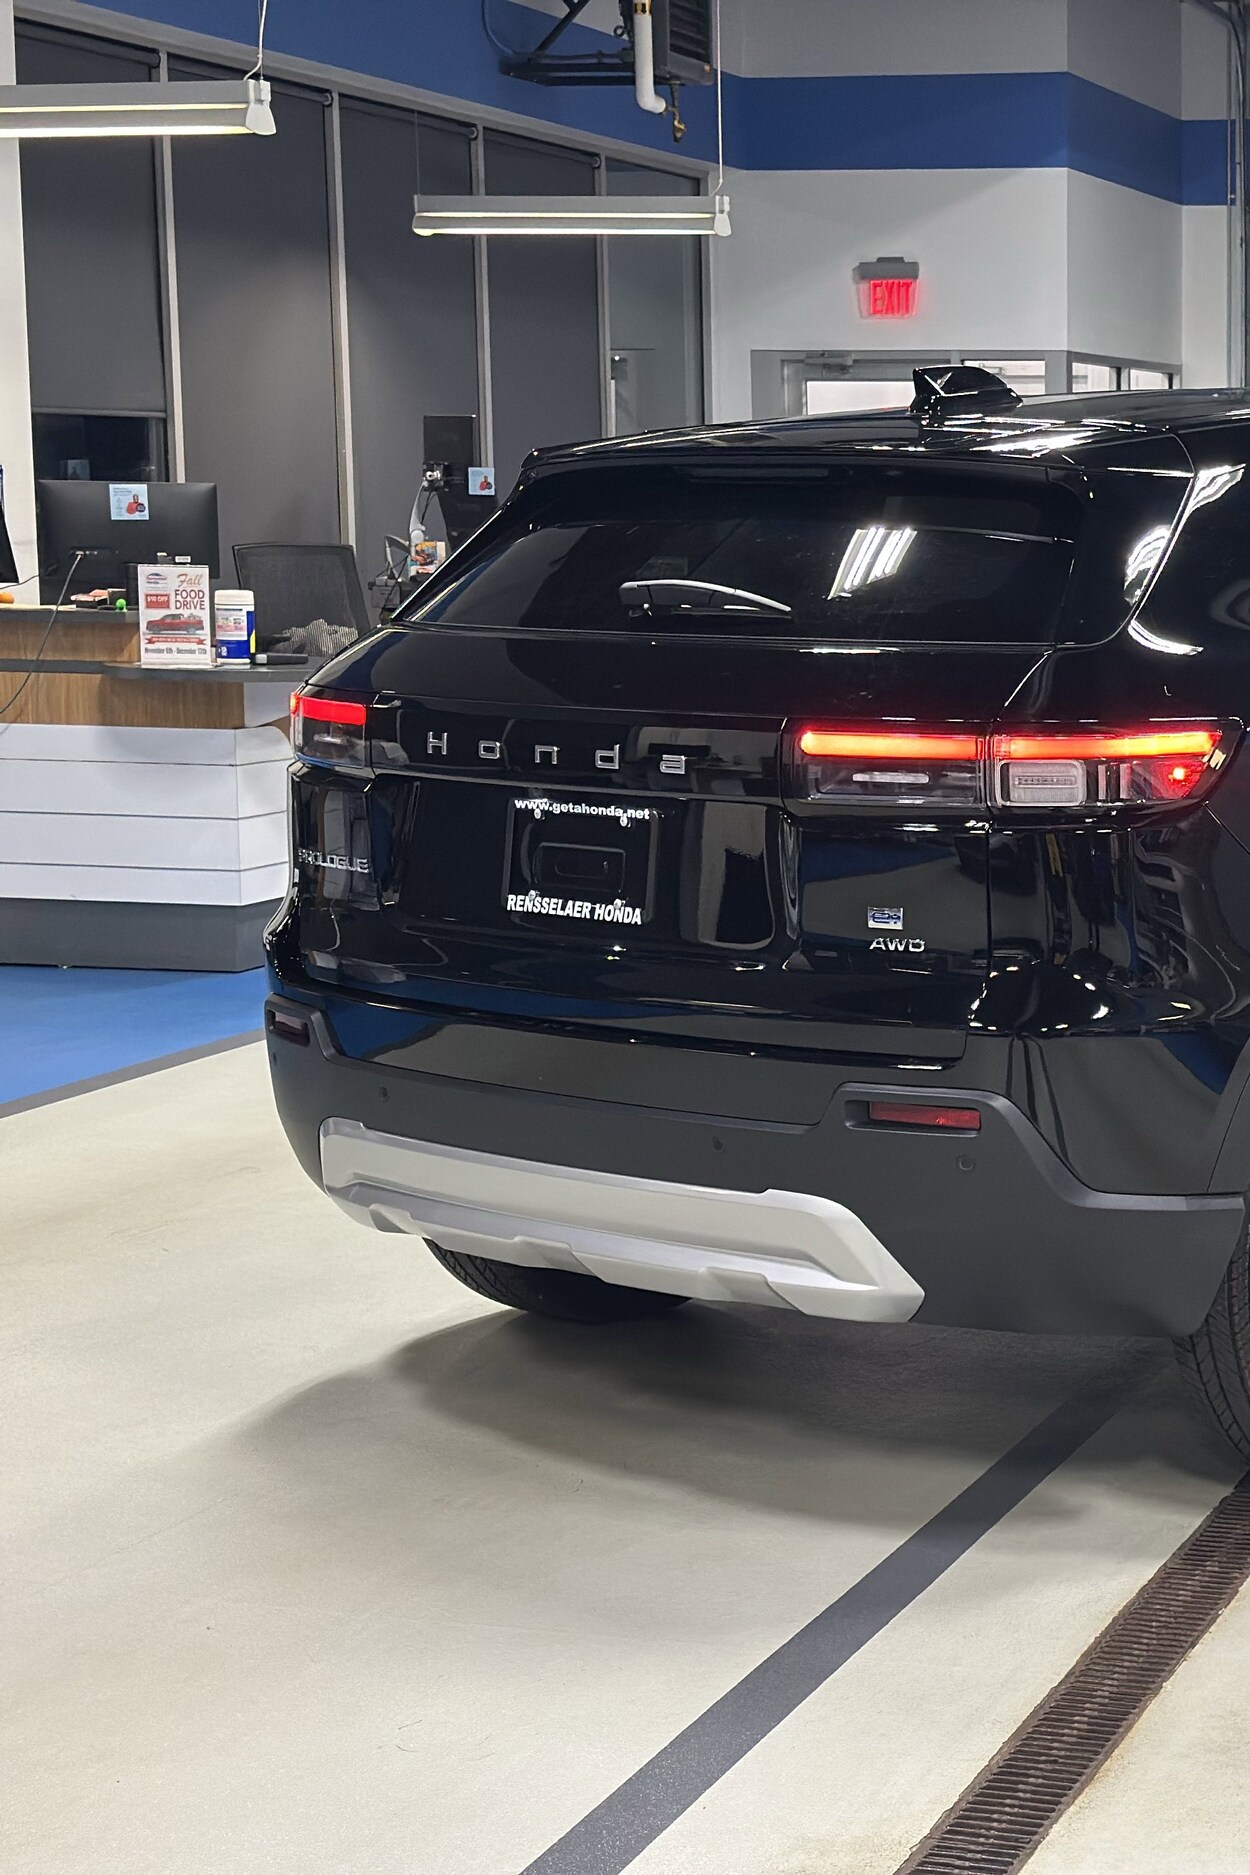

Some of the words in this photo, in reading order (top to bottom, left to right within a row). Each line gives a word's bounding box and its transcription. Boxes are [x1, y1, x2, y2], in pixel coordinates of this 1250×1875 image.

[870, 280, 912, 314] EXIT
[177, 573, 203, 588] Fall
[174, 589, 205, 600] FOOD
[174, 600, 206, 610] DRIVE
[176, 647, 196, 655] December
[426, 731, 686, 775] Honda
[514, 798, 650, 820] www.getahonda.net
[298, 848, 369, 874] PROLOGUE
[507, 894, 592, 919] RENSSELAER
[593, 902, 642, 925] HONDA
[869, 937, 926, 953] AWD
